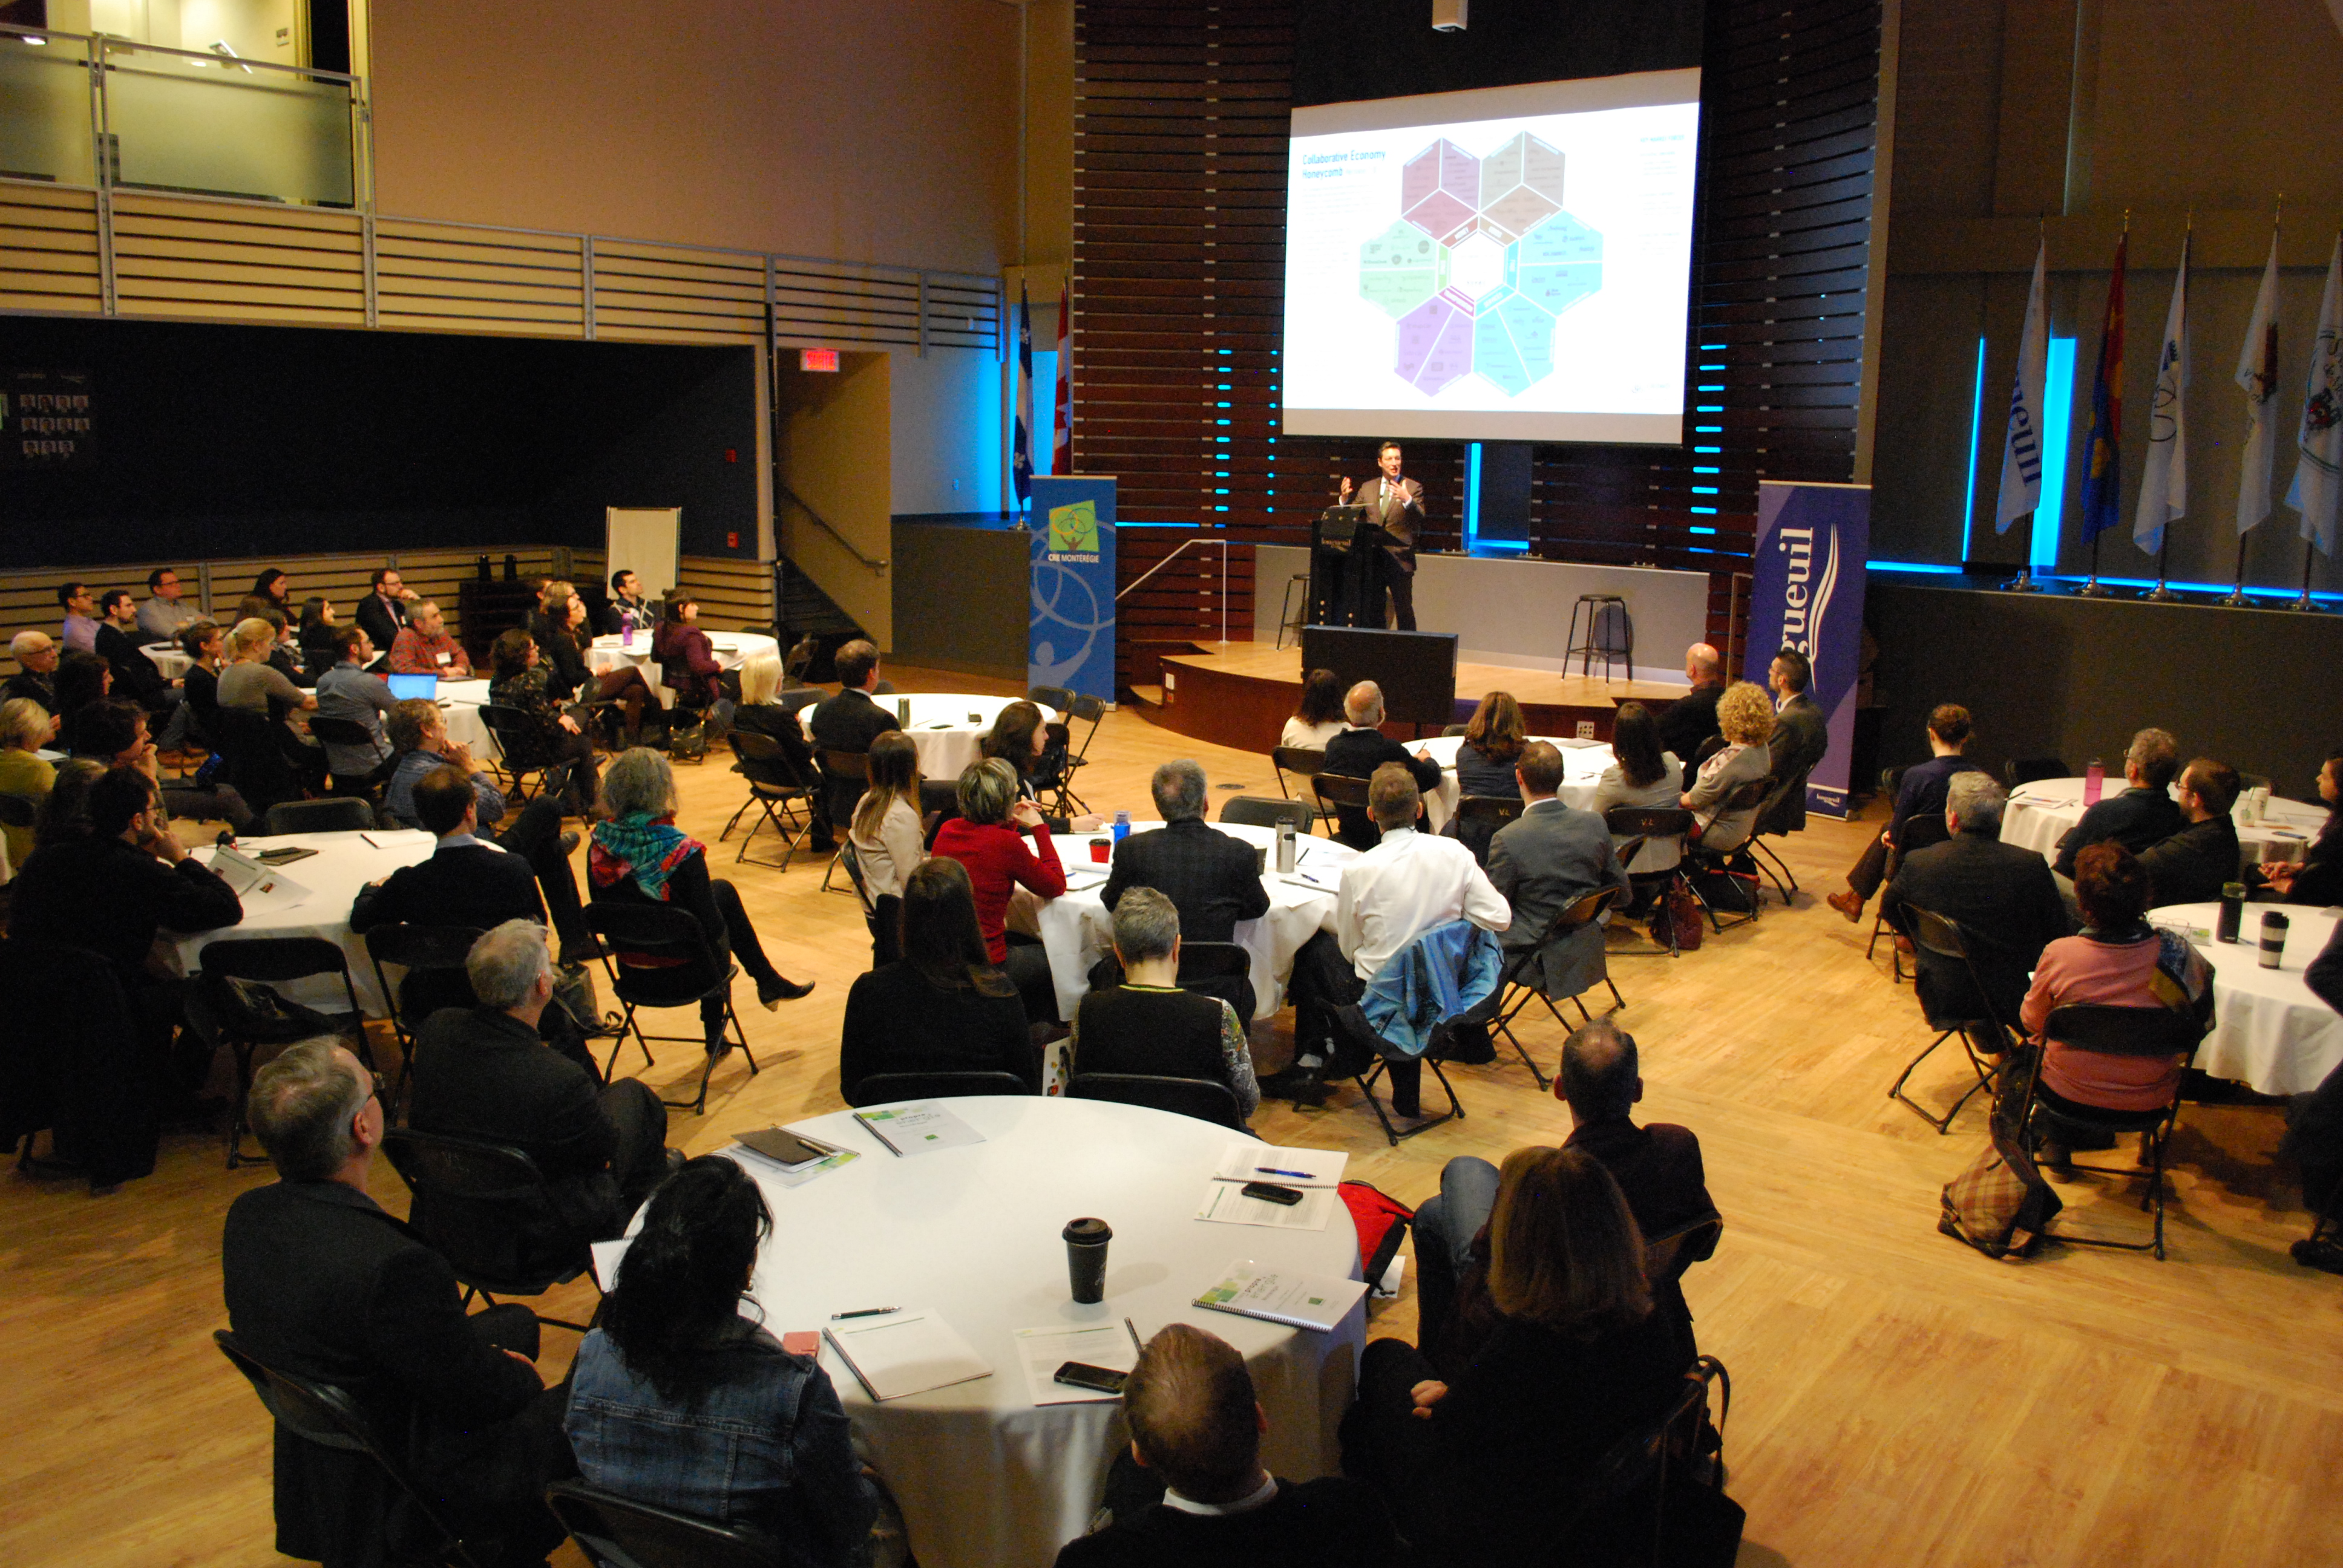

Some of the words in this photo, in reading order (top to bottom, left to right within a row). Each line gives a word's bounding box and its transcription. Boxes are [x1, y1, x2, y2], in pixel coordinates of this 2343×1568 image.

[1303, 152, 1348, 165] Collaborative
[1350, 149, 1386, 162] Economy
[1302, 166, 1343, 180] Honeycomb
